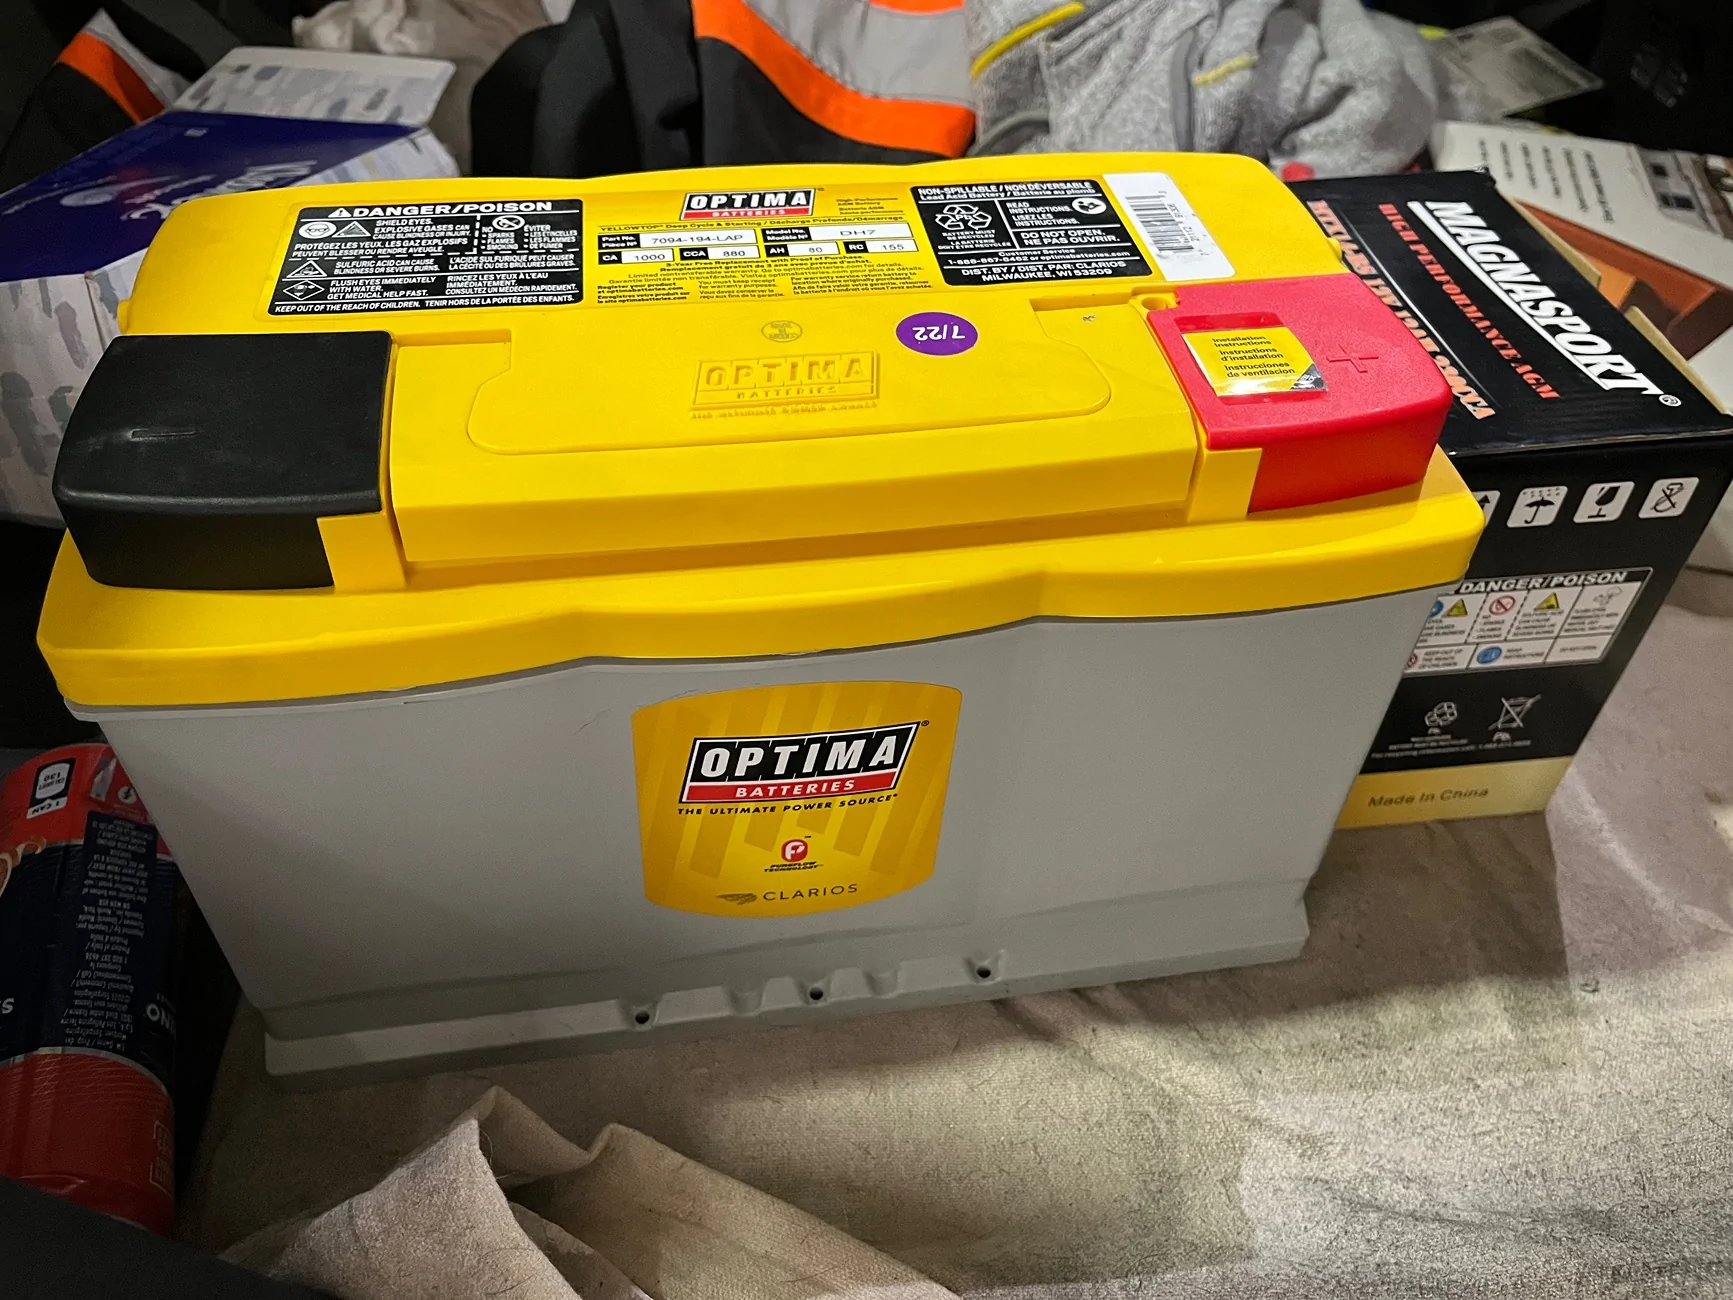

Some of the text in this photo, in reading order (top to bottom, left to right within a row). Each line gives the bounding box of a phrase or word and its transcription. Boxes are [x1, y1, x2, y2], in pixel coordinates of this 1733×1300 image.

[918, 185, 998, 195] NON-SPILLABLE
[1004, 184, 1027, 192] NON
[690, 192, 807, 210] OPTIMA
[353, 202, 552, 217] DANGER/POISON
[1009, 205, 1073, 214] INSTRUCTIONS.
[1015, 218, 1080, 227] INSTRUCTIONS.
[374, 226, 423, 234] EXPLOSIVE
[1041, 230, 1066, 238] NOT
[1068, 229, 1106, 237] OPEN.
[651, 235, 743, 244] 7094-194-LAP
[1070, 235, 1121, 243] OUVRIR.
[294, 242, 340, 250] PROTÉGEZ
[421, 238, 468, 246] EXPLOSIFS
[335, 260, 376, 268] SULFURIC
[450, 256, 479, 264] L'ACIDE
[480, 255, 528, 263] SULFURIQUE
[1048, 263, 1075, 271] PAR:
[381, 276, 437, 285] IMMEDIATELY
[447, 274, 478, 282] RINCEZ
[981, 272, 1055, 281] MILWAUKEE,
[446, 280, 518, 288] IMMÉDIATEMENT.
[406, 289, 429, 297] FAST.
[492, 296, 522, 304] PORTÉE
[1378, 203, 1560, 398] HIGH PERFORMANCE AGM
[275, 305, 296, 313] KEEP
[380, 301, 421, 309] CHILDREN.
[912, 324, 966, 341] 7/22
[1221, 353, 1284, 361] d'installation
[705, 358, 866, 386] OPTIMA
[1460, 571, 1627, 594] DANGER/POISON
[700, 735, 898, 778] OPTIMA
[735, 779, 856, 798] BATTERIES
[1368, 796, 1415, 807] Made
[1440, 787, 1490, 802] China
[31, 803, 52, 815] CAN
[677, 795, 893, 815] THE ULTIMATE POWER SOURCE
[762, 884, 858, 901] CLARIOS
